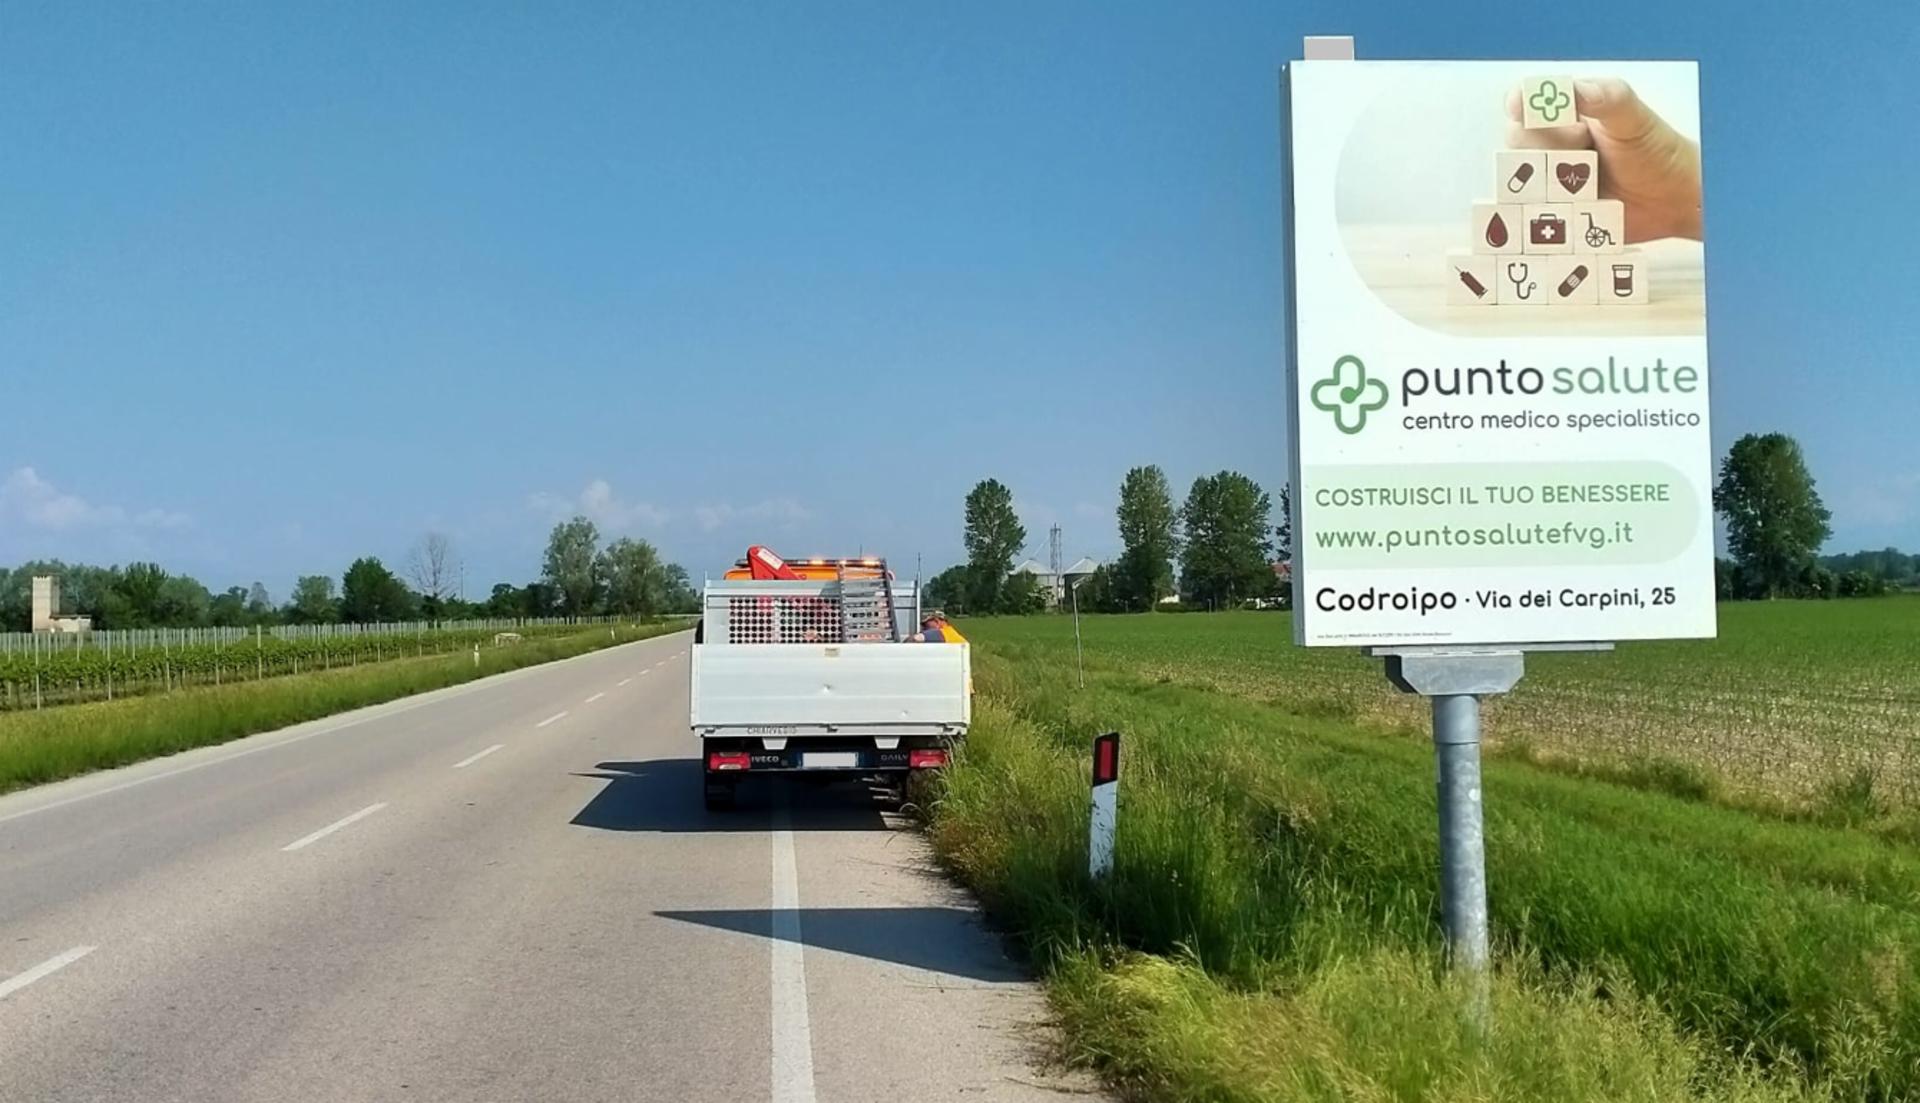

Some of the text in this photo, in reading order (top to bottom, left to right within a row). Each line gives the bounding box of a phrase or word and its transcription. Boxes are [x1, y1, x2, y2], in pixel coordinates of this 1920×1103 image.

[1401, 356, 1699, 407] punto salute
[1402, 409, 1701, 432] centro medico specialistico
[1315, 484, 1670, 507] COSTRUISCI IL TUO BENESSERE
[1315, 522, 1634, 553] www.puntosalutefvg.it
[1316, 586, 1677, 616] Codroipo Via dei Carpini, 25
[751, 755, 780, 763] IVECO
